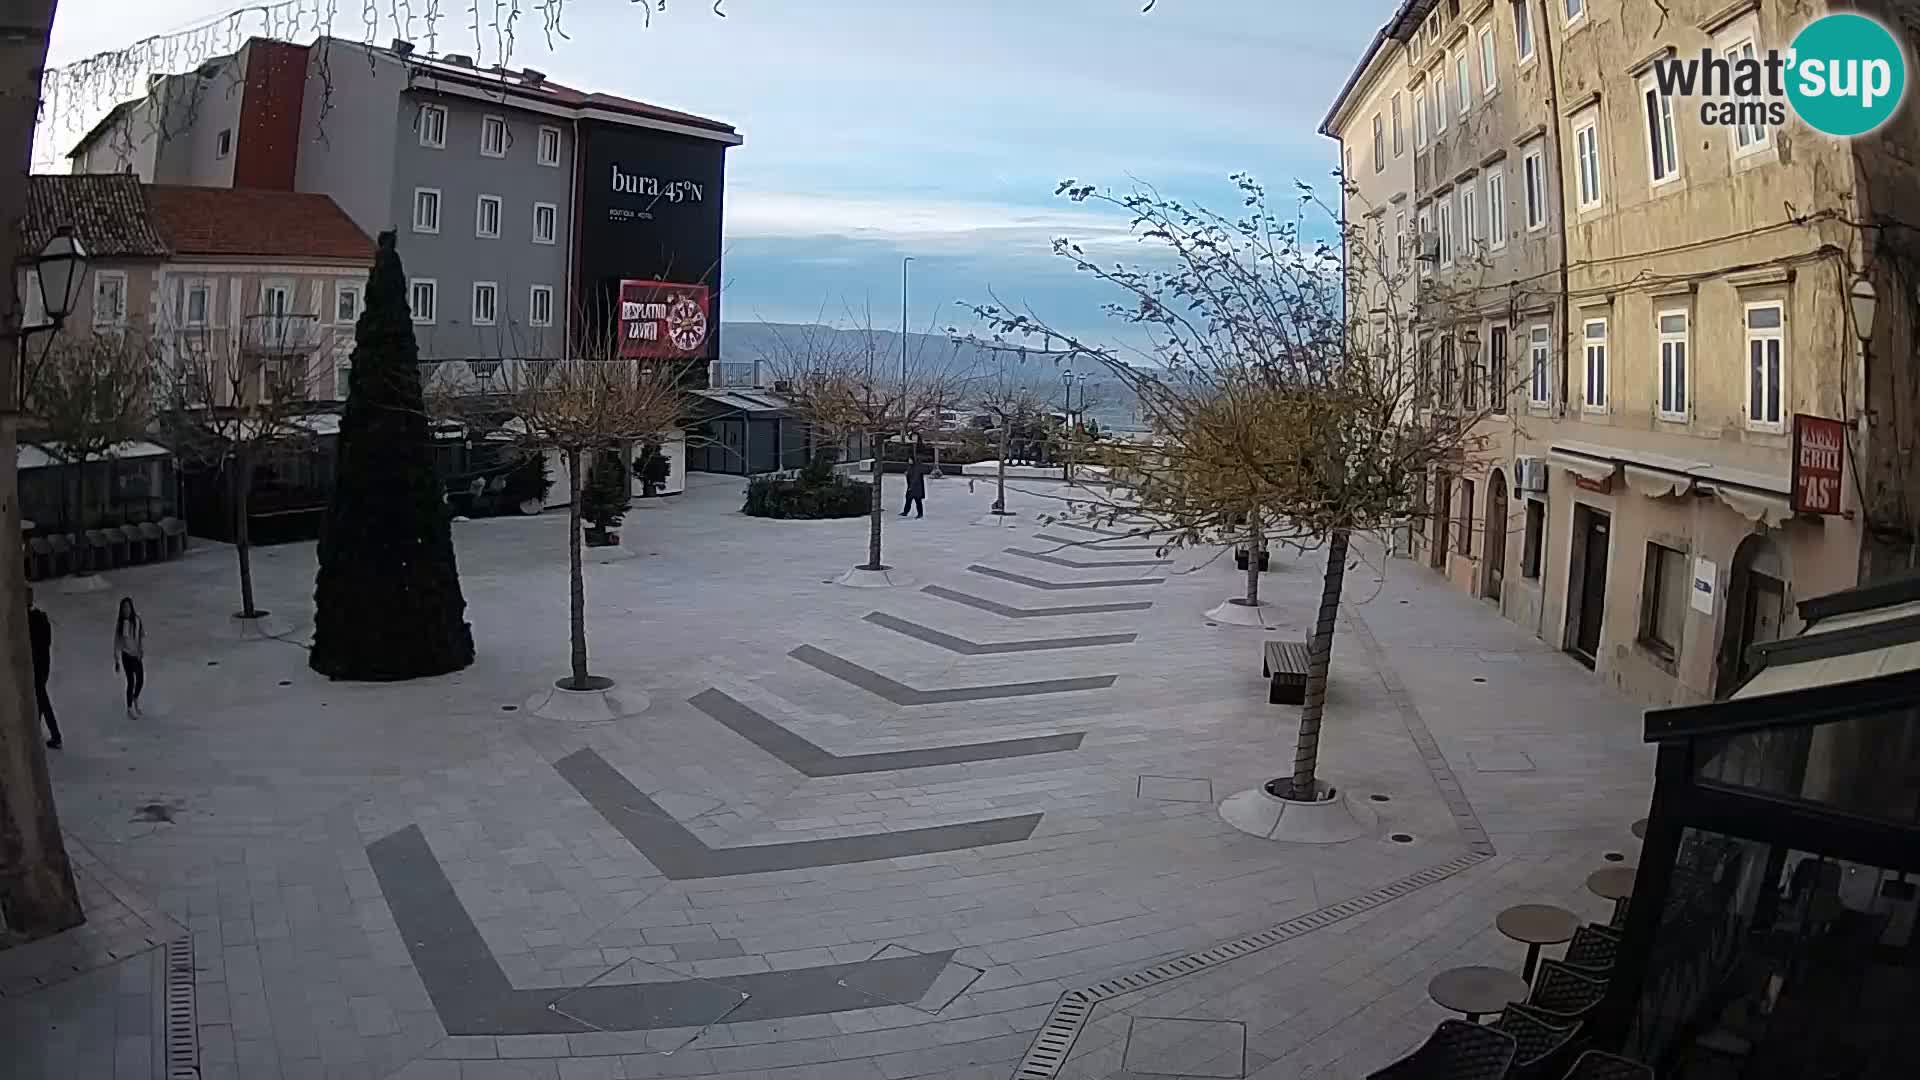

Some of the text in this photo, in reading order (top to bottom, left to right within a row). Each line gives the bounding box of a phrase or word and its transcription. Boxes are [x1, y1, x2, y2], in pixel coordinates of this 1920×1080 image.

[612, 165, 658, 196] bura
[622, 302, 667, 320] BESPLATNO
[628, 321, 658, 340] ZAVRTI
[1800, 448, 1840, 472] GRILL
